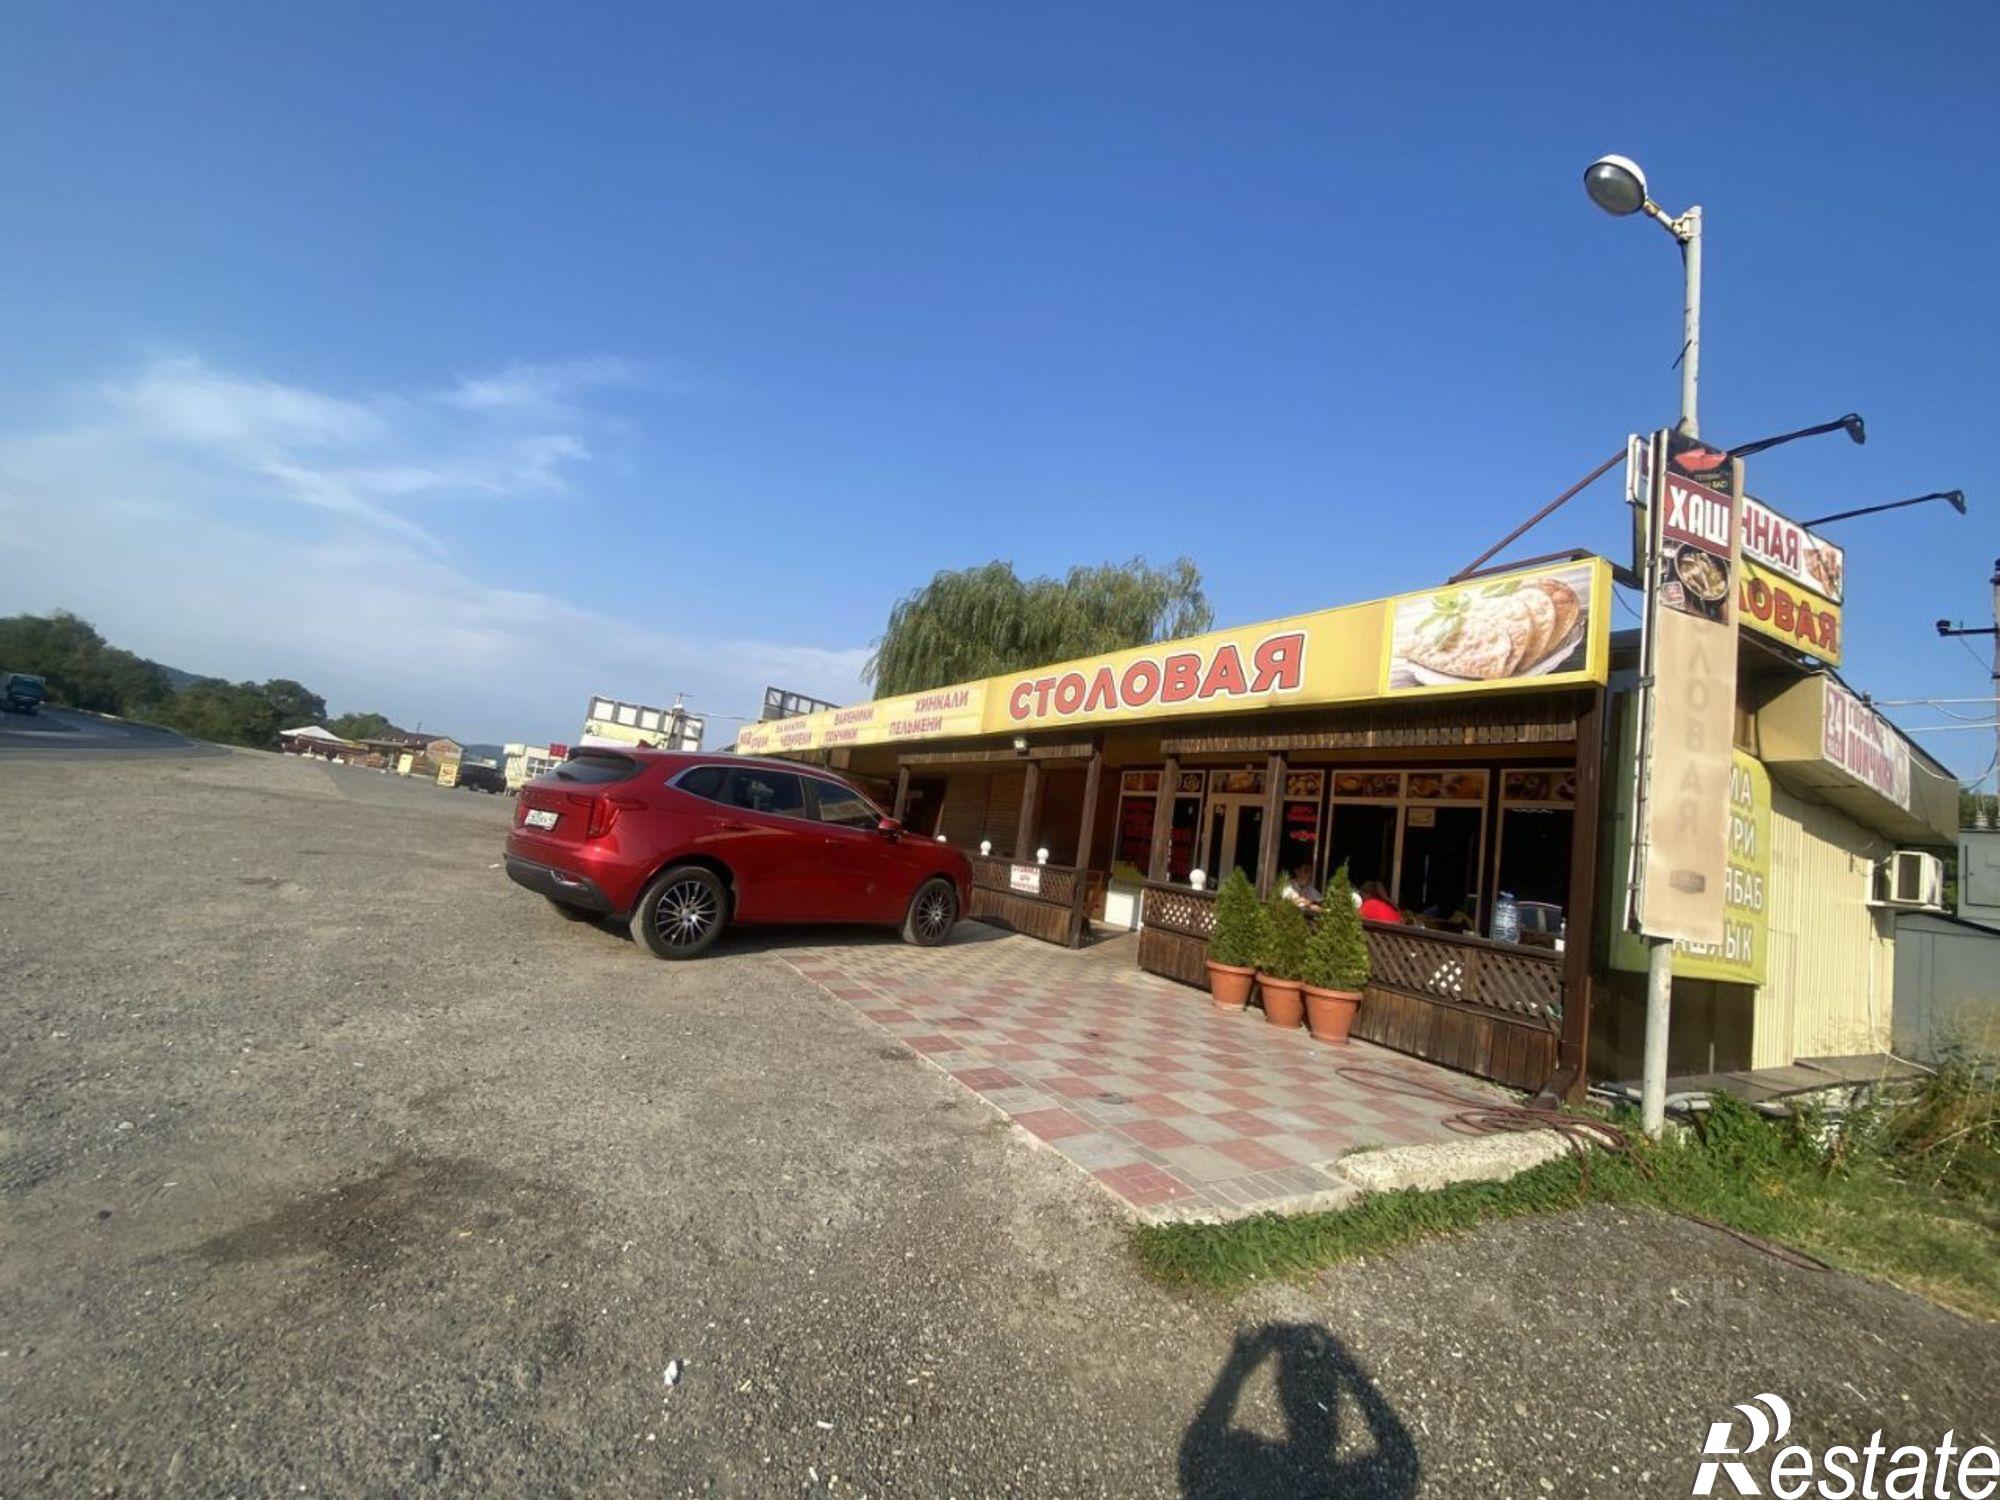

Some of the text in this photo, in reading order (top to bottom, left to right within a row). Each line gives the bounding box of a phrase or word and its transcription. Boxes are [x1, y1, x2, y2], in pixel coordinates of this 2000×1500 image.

[1668, 485, 1730, 547] ХАШ
[1009, 633, 1307, 722] СТОЛОВАЯ
[914, 690, 969, 713] ХИНКАЛИ
[834, 708, 874, 726] ВАРЕНИКИ
[889, 716, 943, 735] ПЕЛЬМЕНИ
